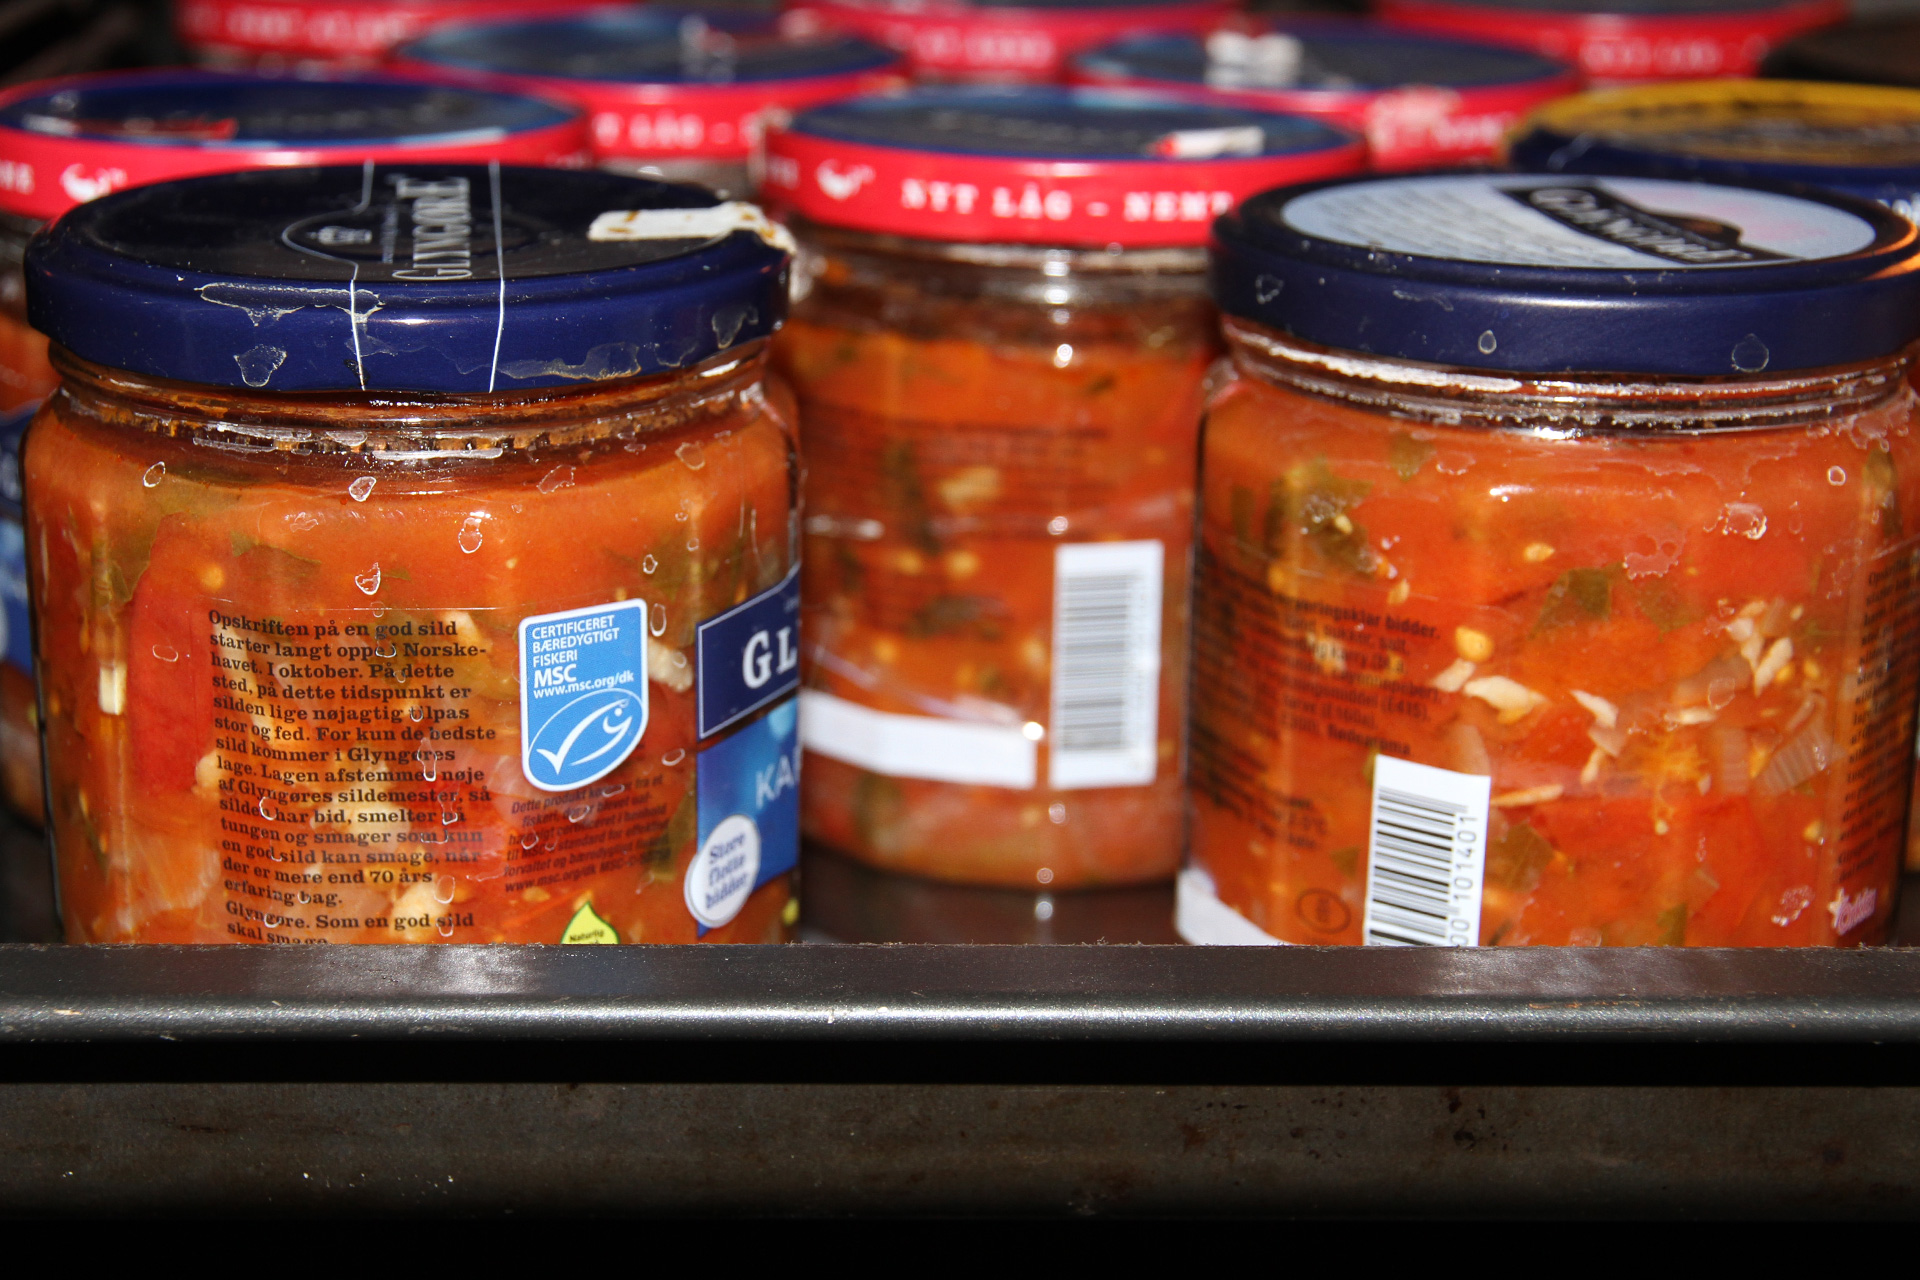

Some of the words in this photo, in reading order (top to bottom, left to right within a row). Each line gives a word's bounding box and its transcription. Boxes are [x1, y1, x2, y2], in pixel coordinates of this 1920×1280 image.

[209, 610, 309, 636] Opskriften
[315, 621, 339, 640] på
[345, 623, 369, 636] en
[375, 621, 412, 640] god
[418, 621, 457, 636] sild
[532, 615, 615, 640] CERTIFICERET
[210, 632, 270, 654] starter
[275, 642, 331, 660] langt
[337, 644, 385, 660] oppe
[404, 643, 486, 656] Norske-
[532, 627, 619, 653] BÆREDYGTIGT
[211, 652, 261, 674] havet.
[268, 663, 275, 676] I
[279, 664, 363, 678] oktober.
[369, 662, 393, 678] På
[404, 664, 454, 678] dette
[533, 650, 578, 667] FISKERI
[212, 674, 252, 695] sted,
[257, 682, 276, 699] på
[283, 685, 334, 699] dette
[341, 685, 444, 702] tidspunkt
[450, 687, 471, 698] er
[534, 664, 576, 688] MSC
[534, 670, 634, 699] www.msc.org/dk
[214, 696, 264, 716] silden
[270, 704, 307, 722] lige
[312, 707, 402, 723] nøjagtig
[410, 706, 469, 723] tilpas
[215, 715, 246, 733] stor
[252, 725, 270, 741] og
[275, 725, 309, 741] fed.
[317, 727, 349, 741] For
[357, 727, 395, 741] kun
[401, 727, 423, 741] de
[430, 726, 495, 740] bedste
[216, 737, 246, 753] sild
[252, 741, 328, 761] kommer
[335, 748, 341, 761] i
[348, 748, 455, 765] Glyngøres
[218, 756, 256, 777] lage.
[261, 765, 319, 786] Lagen
[325, 768, 435, 782] afstemmes
[442, 769, 484, 784] nøje
[219, 778, 234, 793] af
[238, 780, 332, 804] Glyngøres
[339, 789, 462, 803] sildemester,
[469, 787, 491, 802] så
[220, 798, 270, 814] silden
[275, 806, 308, 823] har
[314, 810, 351, 825] bid,
[357, 809, 436, 823] smelter
[512, 799, 541, 814] Dette
[221, 817, 280, 844] tungen
[285, 831, 307, 846] og
[314, 830, 391, 846] smager
[396, 830, 437, 842] som
[446, 829, 482, 842] kun
[222, 840, 242, 852] en
[246, 843, 274, 861] god
[281, 848, 315, 864] sild
[322, 850, 359, 864] kan
[366, 850, 439, 866] smage,
[445, 848, 480, 862] når
[224, 858, 249, 874] der
[254, 865, 270, 878] er
[275, 869, 323, 884] mere
[328, 870, 363, 883] end
[369, 871, 393, 883] 70
[399, 867, 432, 883] års
[225, 878, 294, 907] erfaring
[300, 890, 342, 907] bag.
[226, 901, 310, 928] Glyngøre.
[316, 914, 358, 928] Som
[365, 917, 388, 927] en
[394, 914, 430, 931] god
[436, 913, 473, 927] sild
[228, 922, 262, 941] skal
